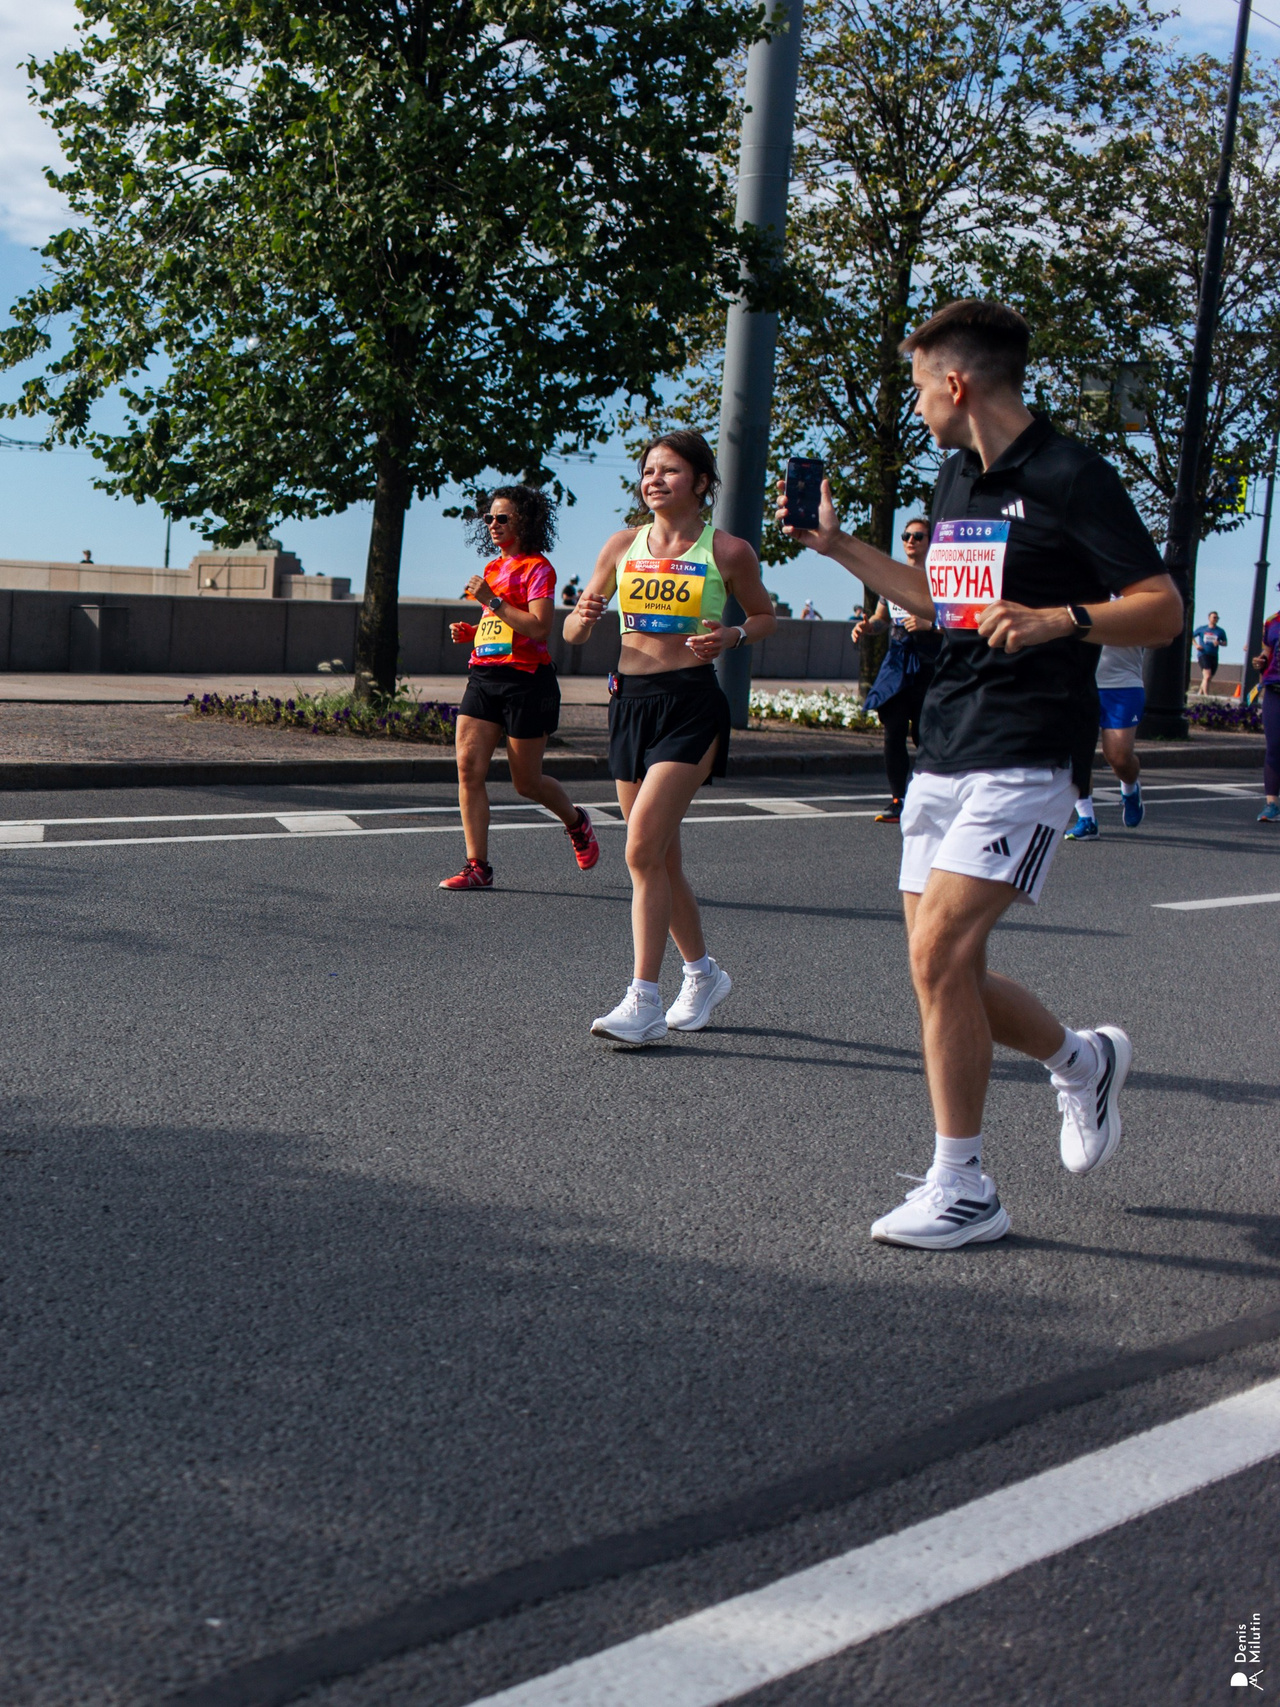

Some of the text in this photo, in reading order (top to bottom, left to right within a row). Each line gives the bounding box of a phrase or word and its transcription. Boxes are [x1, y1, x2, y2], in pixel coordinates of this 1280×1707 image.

[960, 527, 992, 536] 2026
[930, 548, 997, 563] СОПРОВОЖДЕНИЕ
[929, 565, 995, 598] БЕГУНА
[629, 577, 691, 603] 2086
[644, 602, 672, 611] ИРИНА
[627, 614, 635, 627] D
[481, 620, 502, 637] 975
